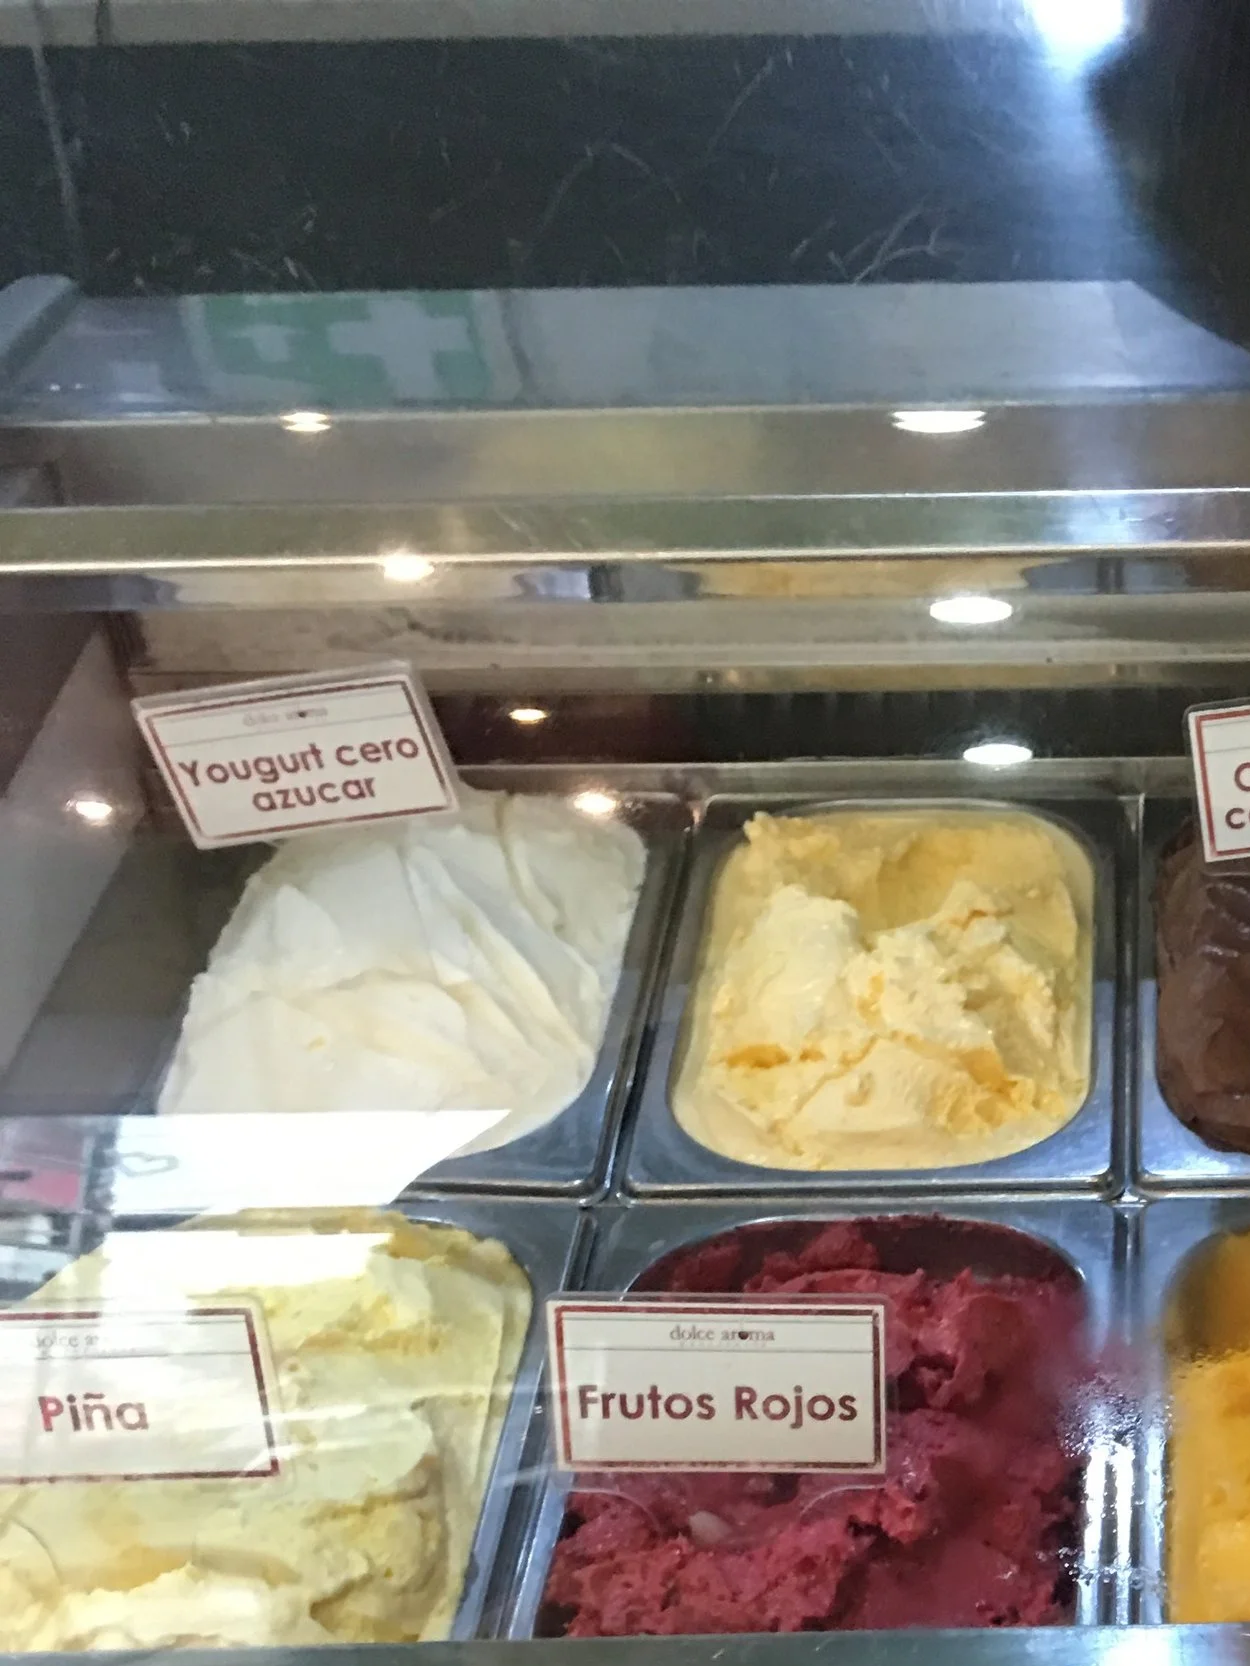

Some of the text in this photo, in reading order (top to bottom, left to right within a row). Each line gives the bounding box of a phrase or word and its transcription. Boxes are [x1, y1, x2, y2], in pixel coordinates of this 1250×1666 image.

[178, 736, 420, 787] Yougurt cero
[252, 777, 377, 812] azucar
[669, 1324, 715, 1341] dolce
[38, 1392, 149, 1432] Piña
[578, 1384, 858, 1429] Frutos Rojos
